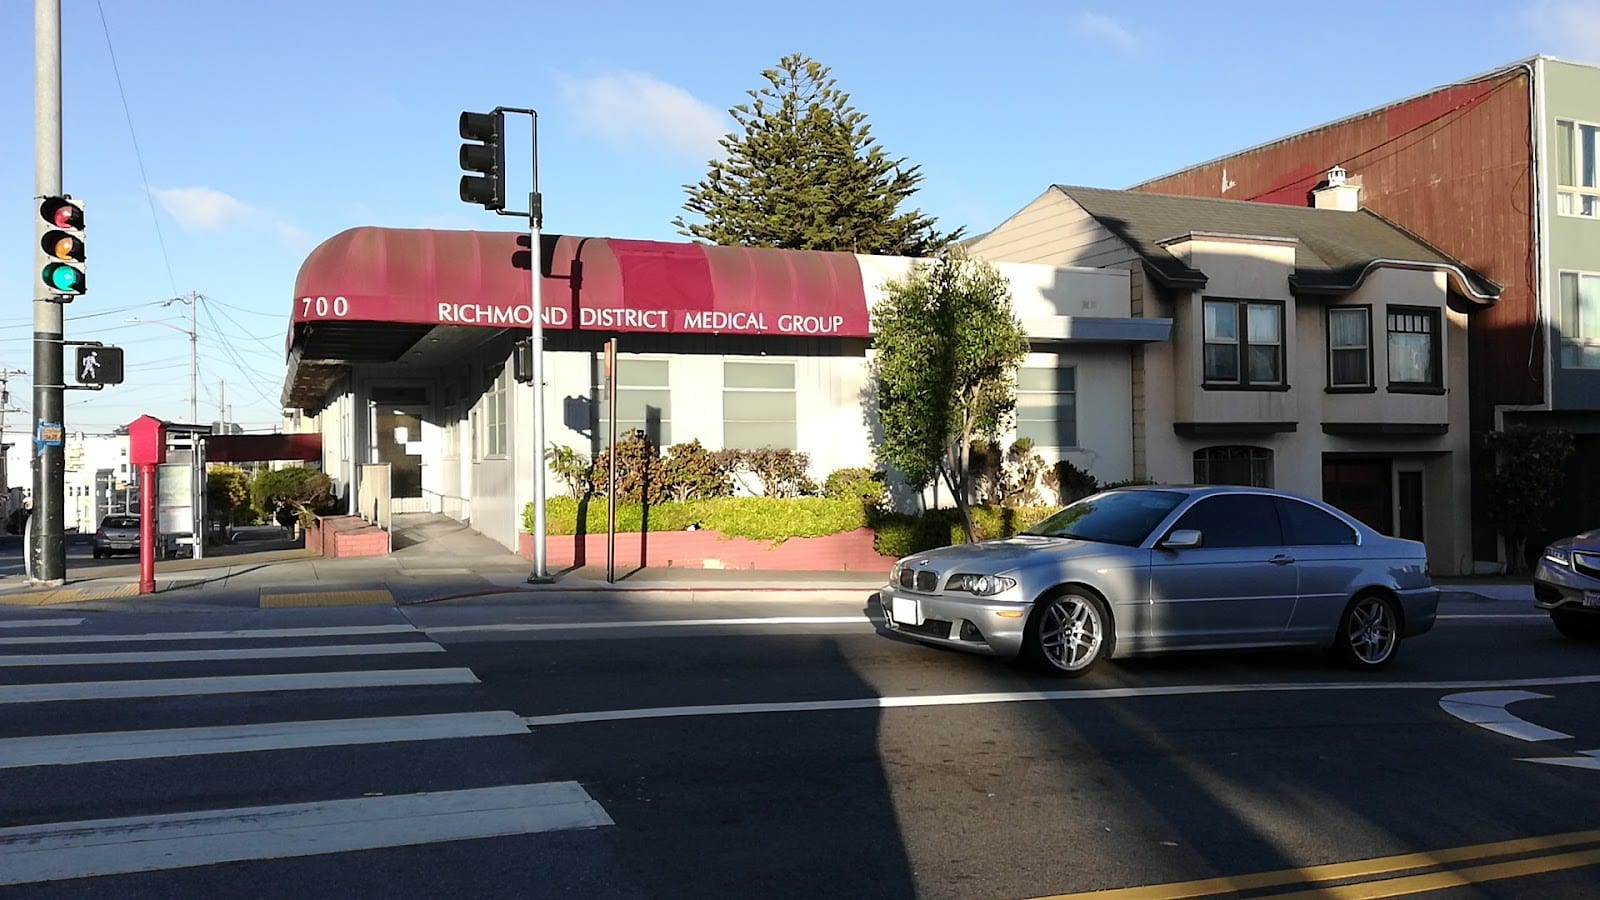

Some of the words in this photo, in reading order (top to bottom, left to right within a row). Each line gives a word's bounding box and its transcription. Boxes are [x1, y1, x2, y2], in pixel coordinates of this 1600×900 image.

[302, 296, 348, 318] 700
[438, 302, 568, 326] RICHMOND
[580, 307, 668, 329] DISTRICT
[684, 311, 768, 330] MEDICAL
[777, 314, 844, 334] GROUP
